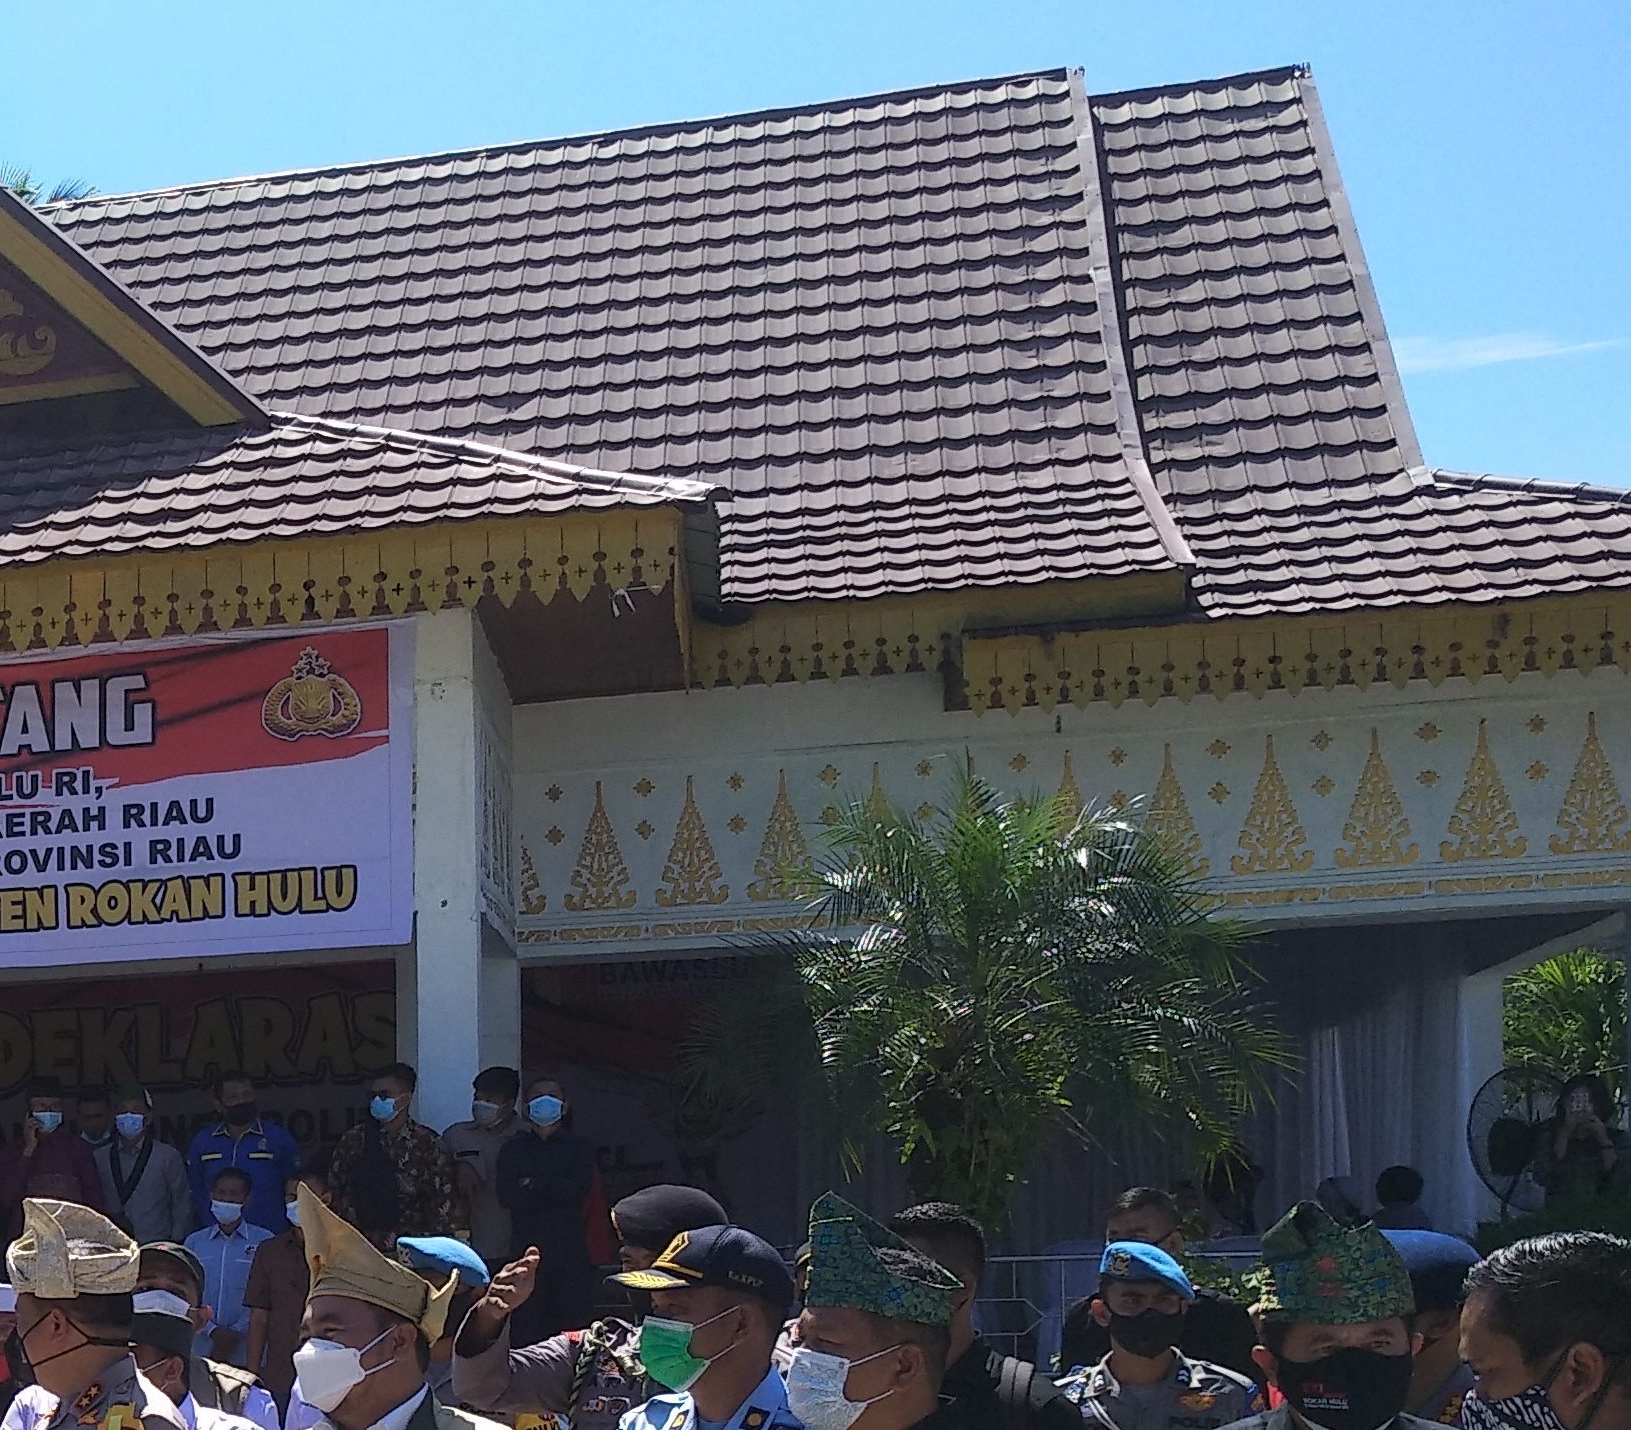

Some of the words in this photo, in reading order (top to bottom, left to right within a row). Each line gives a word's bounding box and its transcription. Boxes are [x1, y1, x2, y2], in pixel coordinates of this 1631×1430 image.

[55, 769, 104, 800] RI,
[123, 797, 215, 830] RIAU
[148, 833, 242, 865] RIAU
[66, 873, 227, 932] ROKAN
[232, 865, 357, 918] HULU
